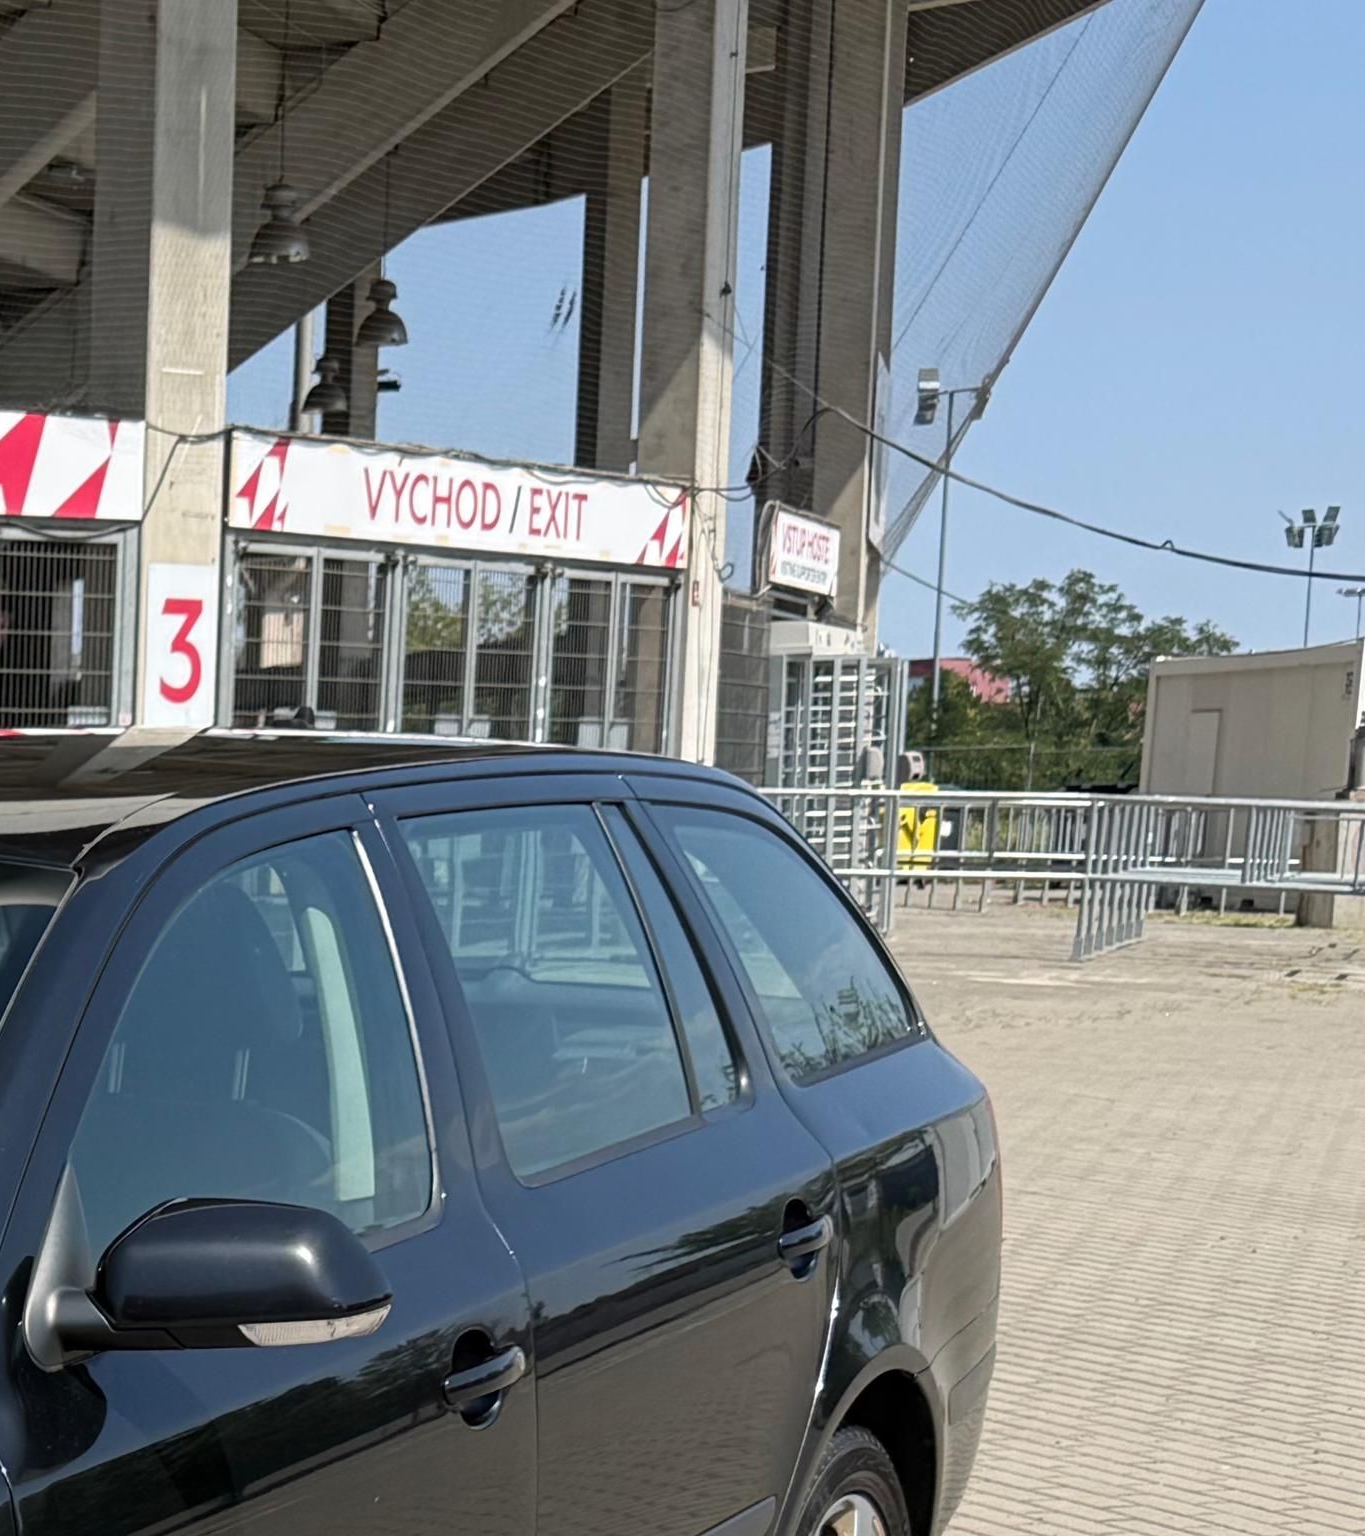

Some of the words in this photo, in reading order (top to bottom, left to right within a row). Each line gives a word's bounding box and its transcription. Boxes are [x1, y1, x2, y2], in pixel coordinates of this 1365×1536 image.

[364, 457, 501, 532] VÝCHOD
[529, 487, 588, 541] EXIT
[159, 598, 203, 704] 3
